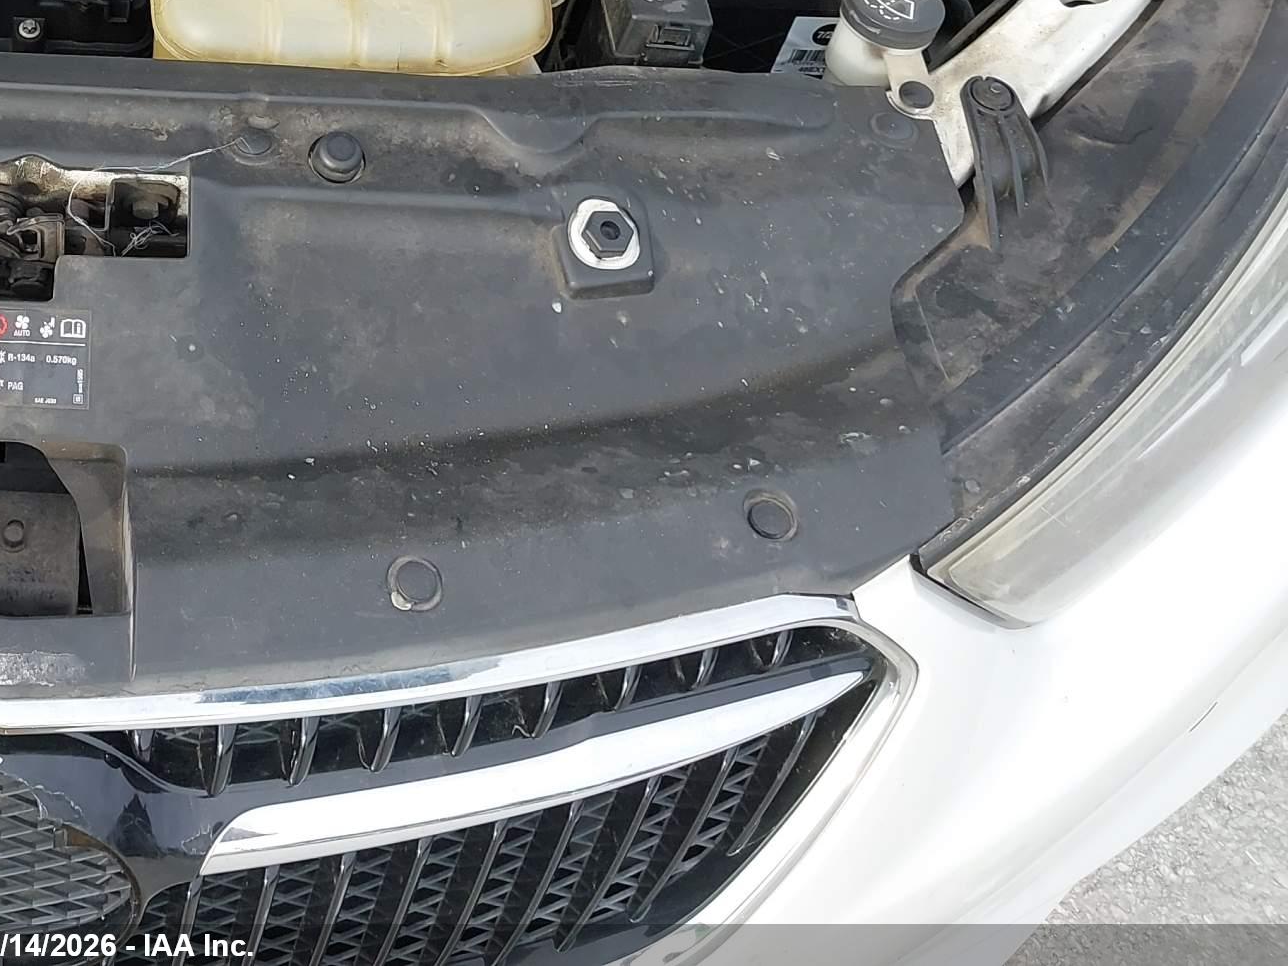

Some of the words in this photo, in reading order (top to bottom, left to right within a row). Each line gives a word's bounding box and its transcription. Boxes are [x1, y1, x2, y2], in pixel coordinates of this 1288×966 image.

[13, 329, 31, 337] AUTO
[7, 353, 36, 363] R-134a
[7, 381, 24, 391] PAG
